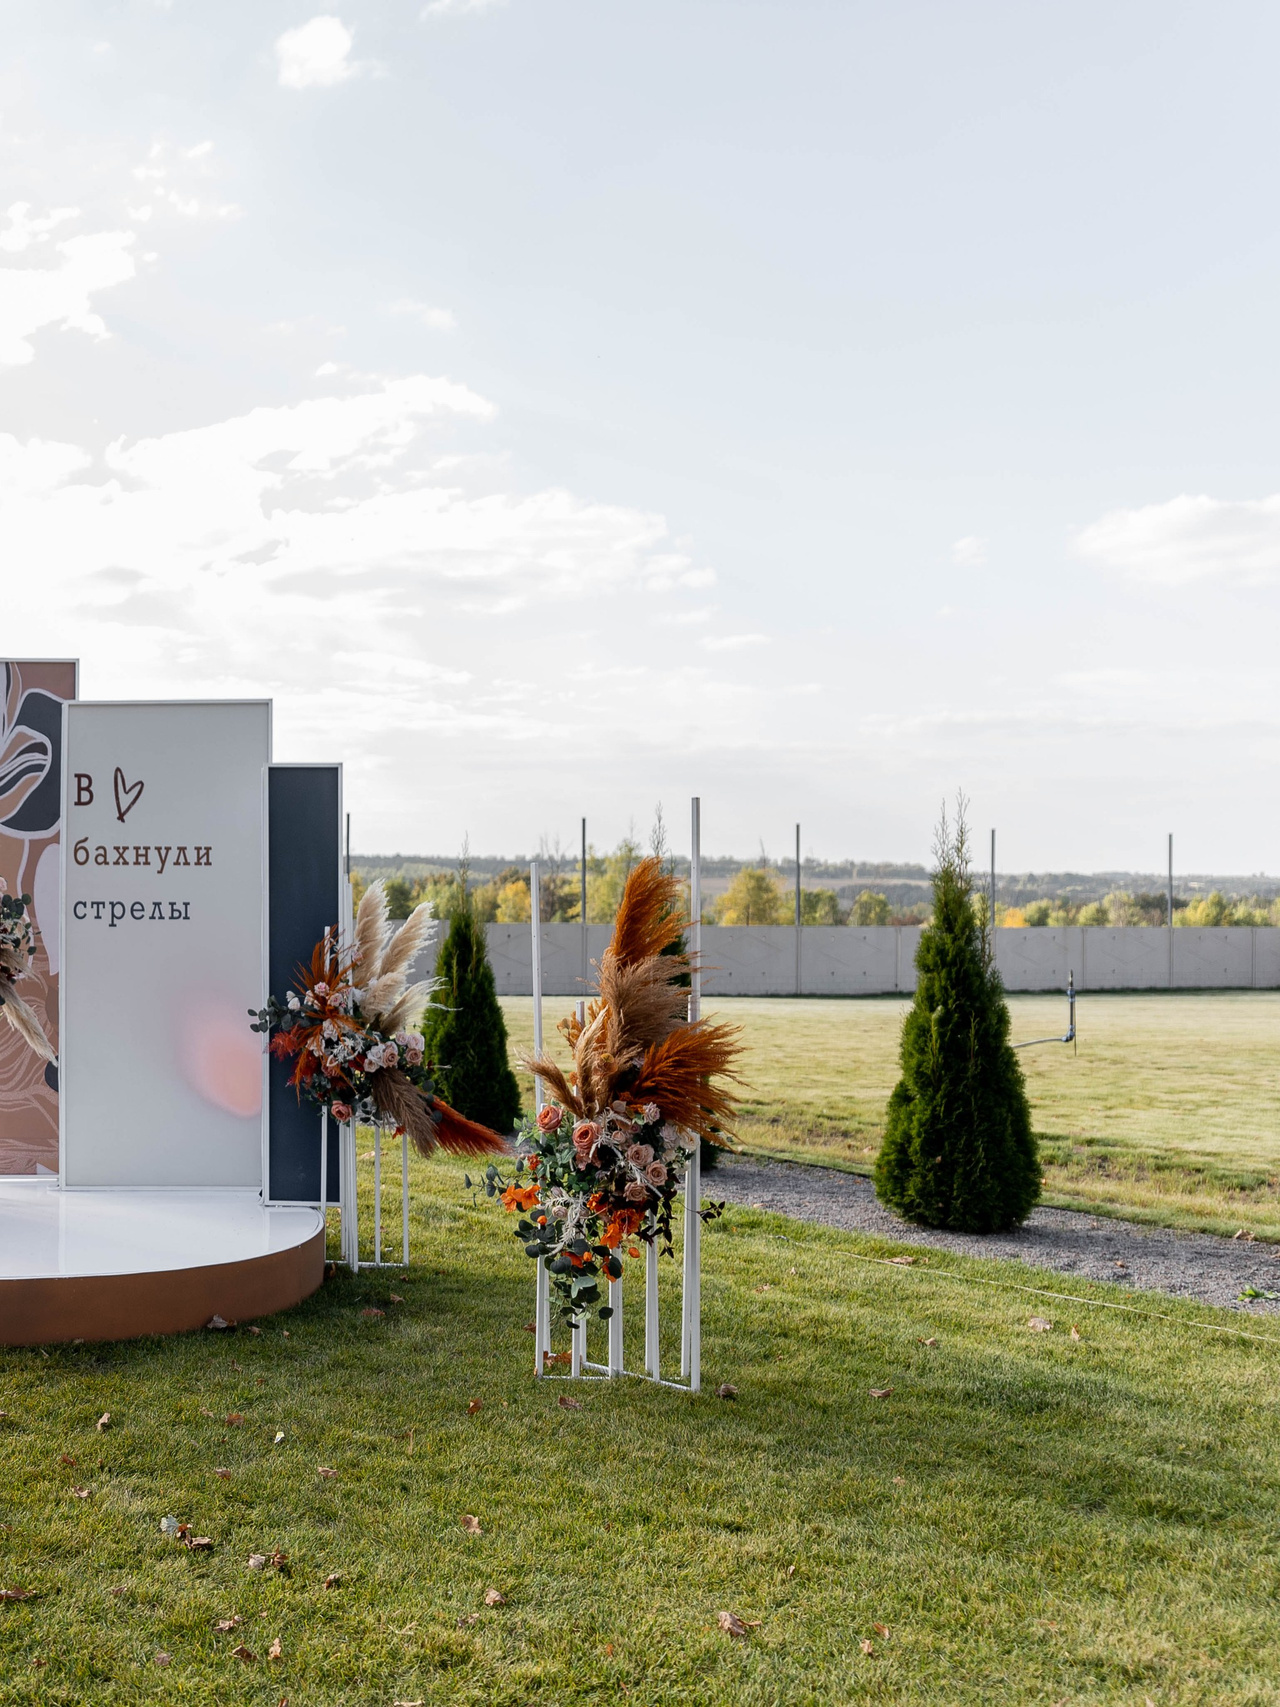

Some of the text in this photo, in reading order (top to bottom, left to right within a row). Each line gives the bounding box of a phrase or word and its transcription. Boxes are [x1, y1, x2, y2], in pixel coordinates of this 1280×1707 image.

[73, 772, 95, 807] В
[73, 836, 213, 875] бахнули
[73, 900, 191, 928] стрелы
